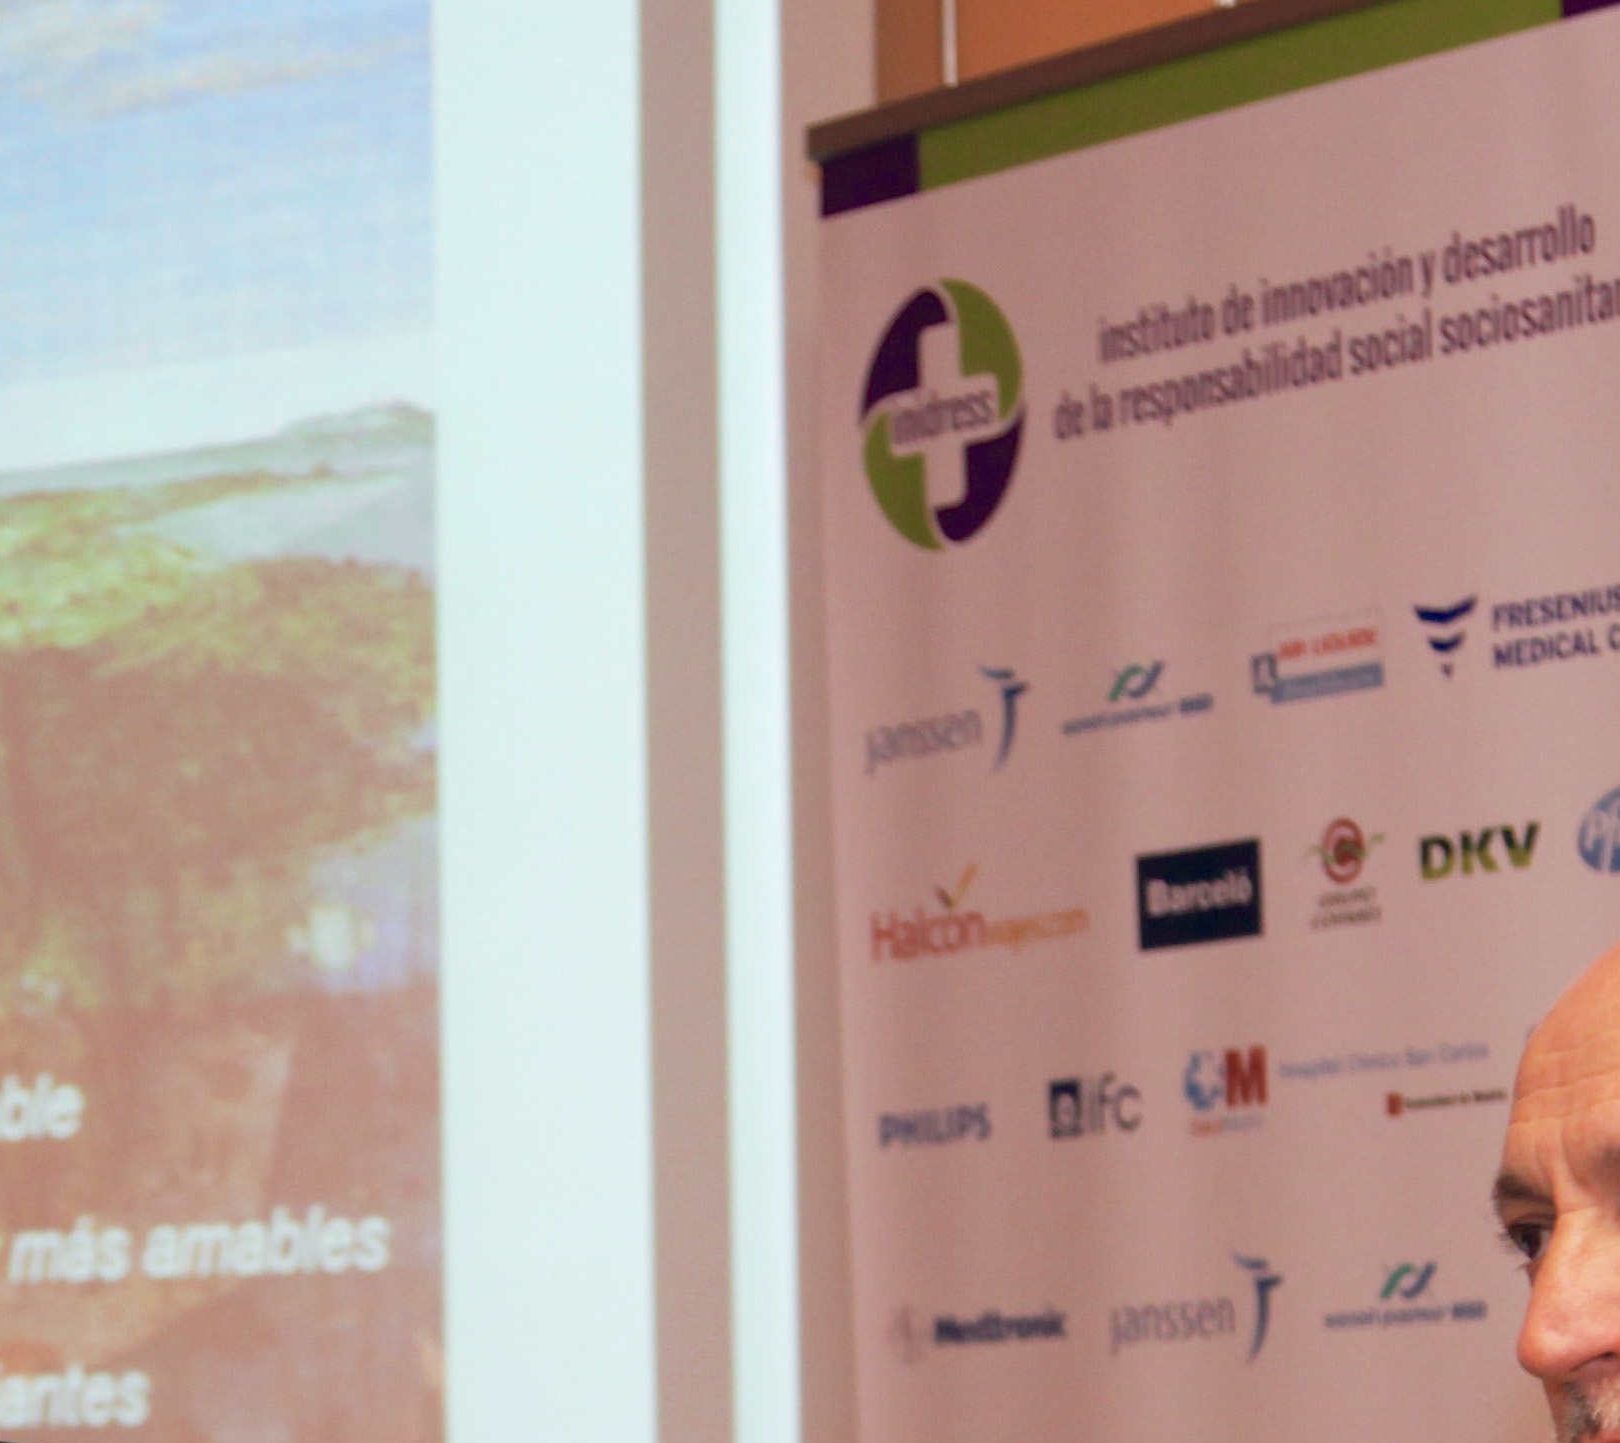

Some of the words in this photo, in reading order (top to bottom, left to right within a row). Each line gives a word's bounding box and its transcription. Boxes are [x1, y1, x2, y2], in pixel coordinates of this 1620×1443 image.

[1099, 297, 1217, 365] instituto
[1222, 283, 1256, 336] de
[1260, 245, 1415, 327] innovación
[1417, 250, 1438, 297] y
[1443, 202, 1596, 284] desarrollo
[1054, 390, 1085, 442] de
[1088, 382, 1114, 433] la
[1119, 328, 1344, 428] responsabilidad
[1348, 309, 1435, 376] social
[1492, 628, 1602, 670] MEDICAL
[1419, 820, 1542, 882] DKV
[1145, 867, 1254, 918] Barceló
[8, 1214, 133, 1284] más
[141, 1203, 394, 1279] amables
[933, 1307, 1068, 1346] Medtronic
[1108, 1296, 1237, 1354] janssen
